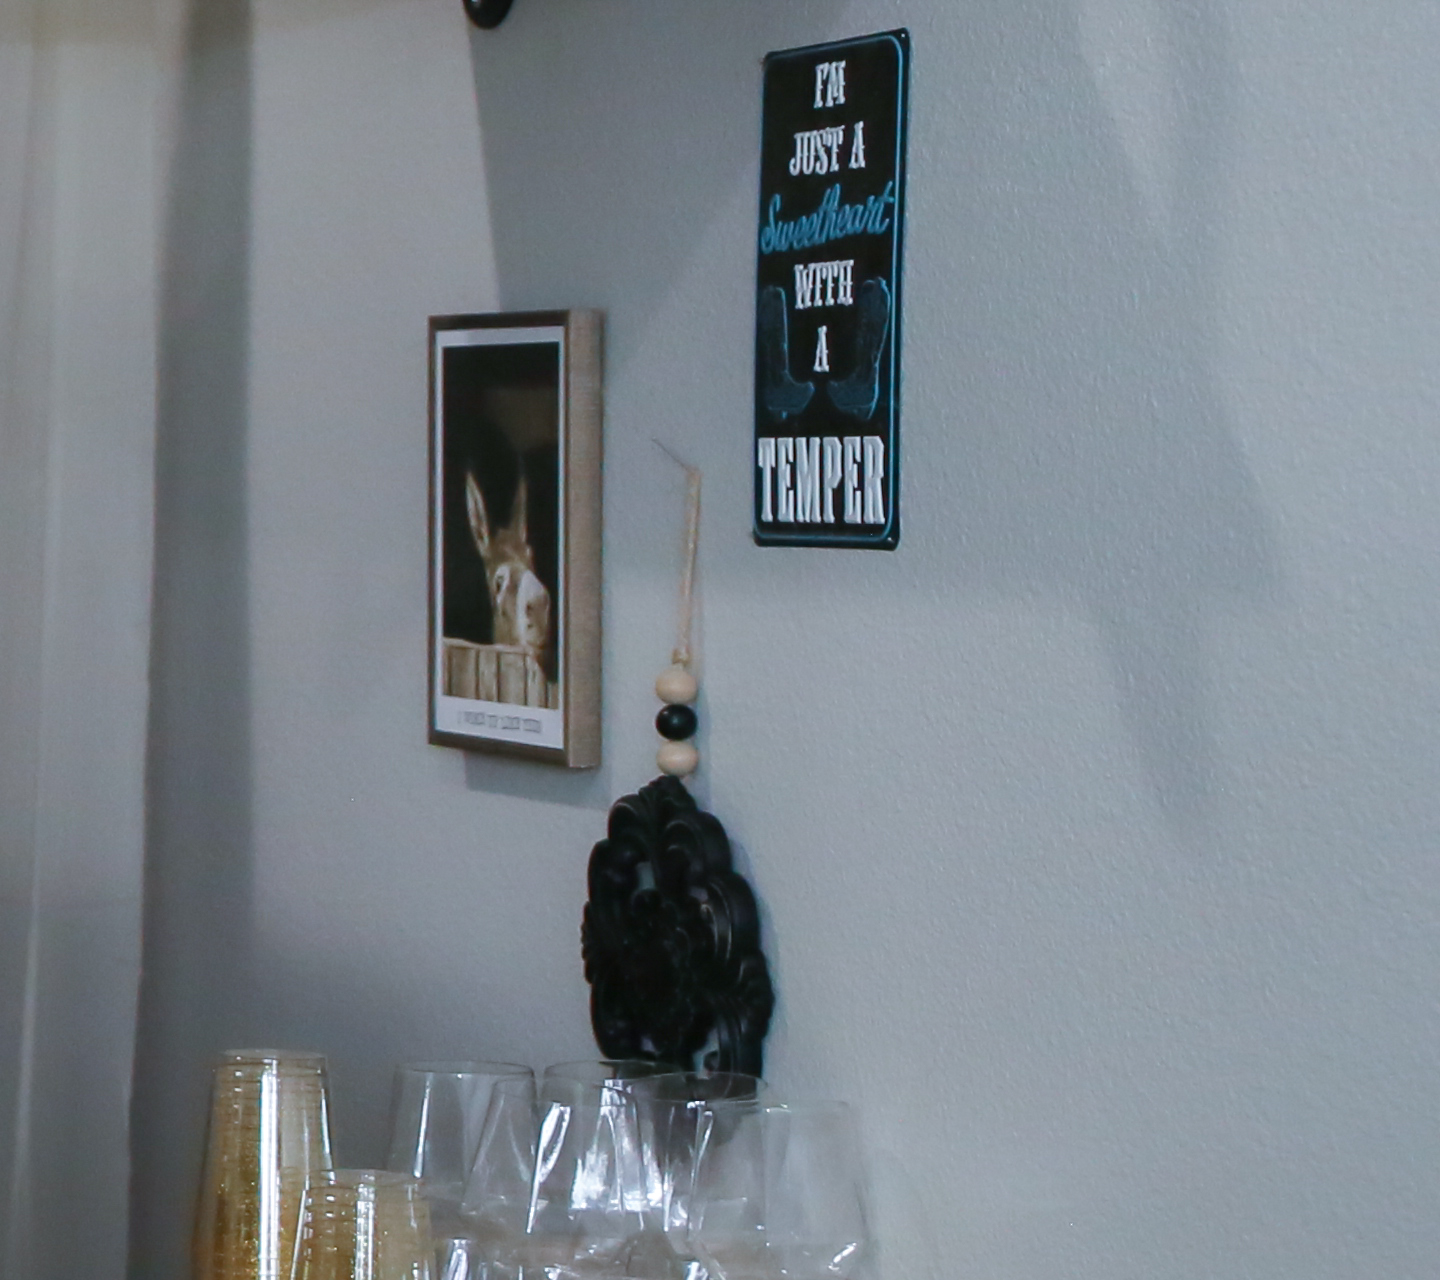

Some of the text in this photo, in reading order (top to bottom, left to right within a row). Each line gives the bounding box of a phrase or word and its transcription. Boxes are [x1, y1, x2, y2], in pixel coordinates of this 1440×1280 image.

[790, 120, 866, 177] JUST A
[760, 182, 895, 255] Sweetheart
[793, 259, 854, 310] WITH
[813, 325, 830, 373] A
[757, 435, 886, 525] TEMPER
